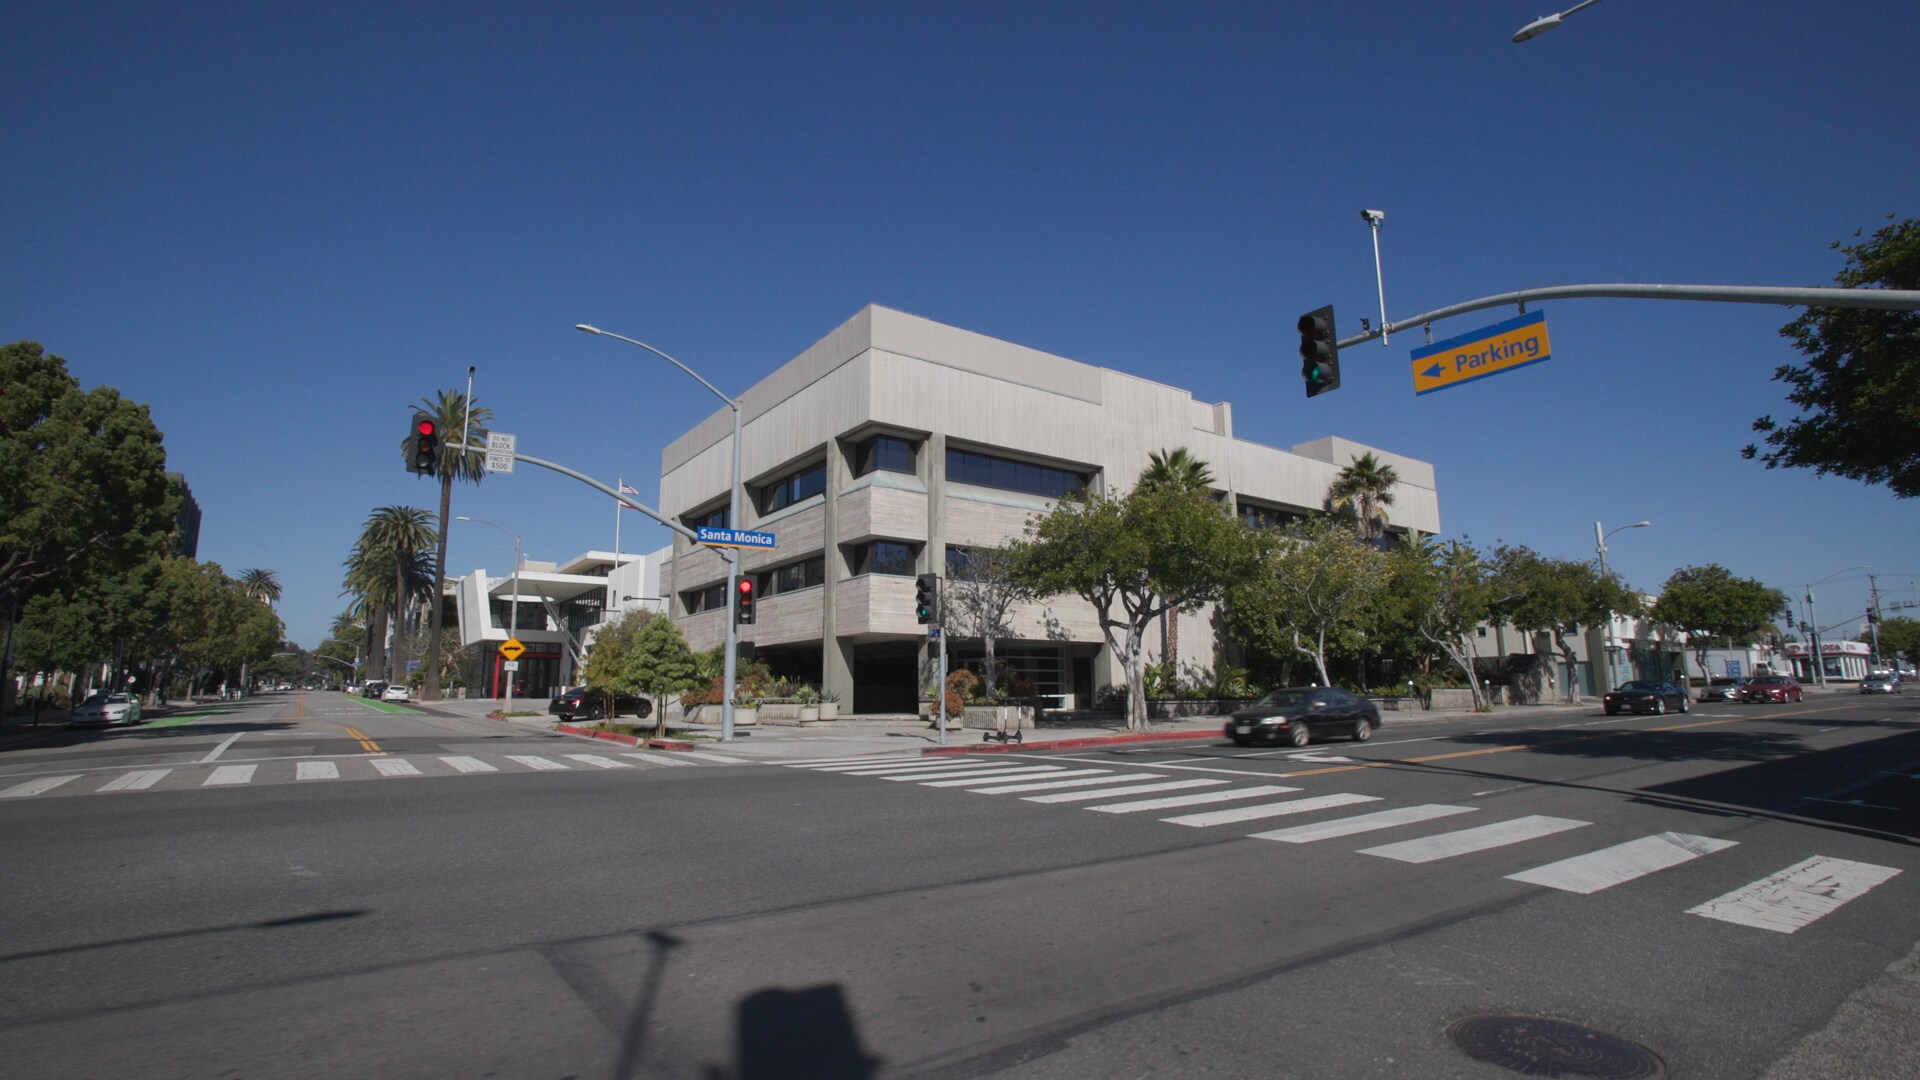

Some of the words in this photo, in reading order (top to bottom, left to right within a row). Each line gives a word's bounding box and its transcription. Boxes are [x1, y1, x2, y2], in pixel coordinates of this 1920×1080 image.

[1455, 336, 1539, 372] Parking
[492, 441, 511, 450] BLOCK
[492, 463, 508, 471] $500
[700, 528, 731, 541] Santa
[734, 531, 772, 544] Monica
